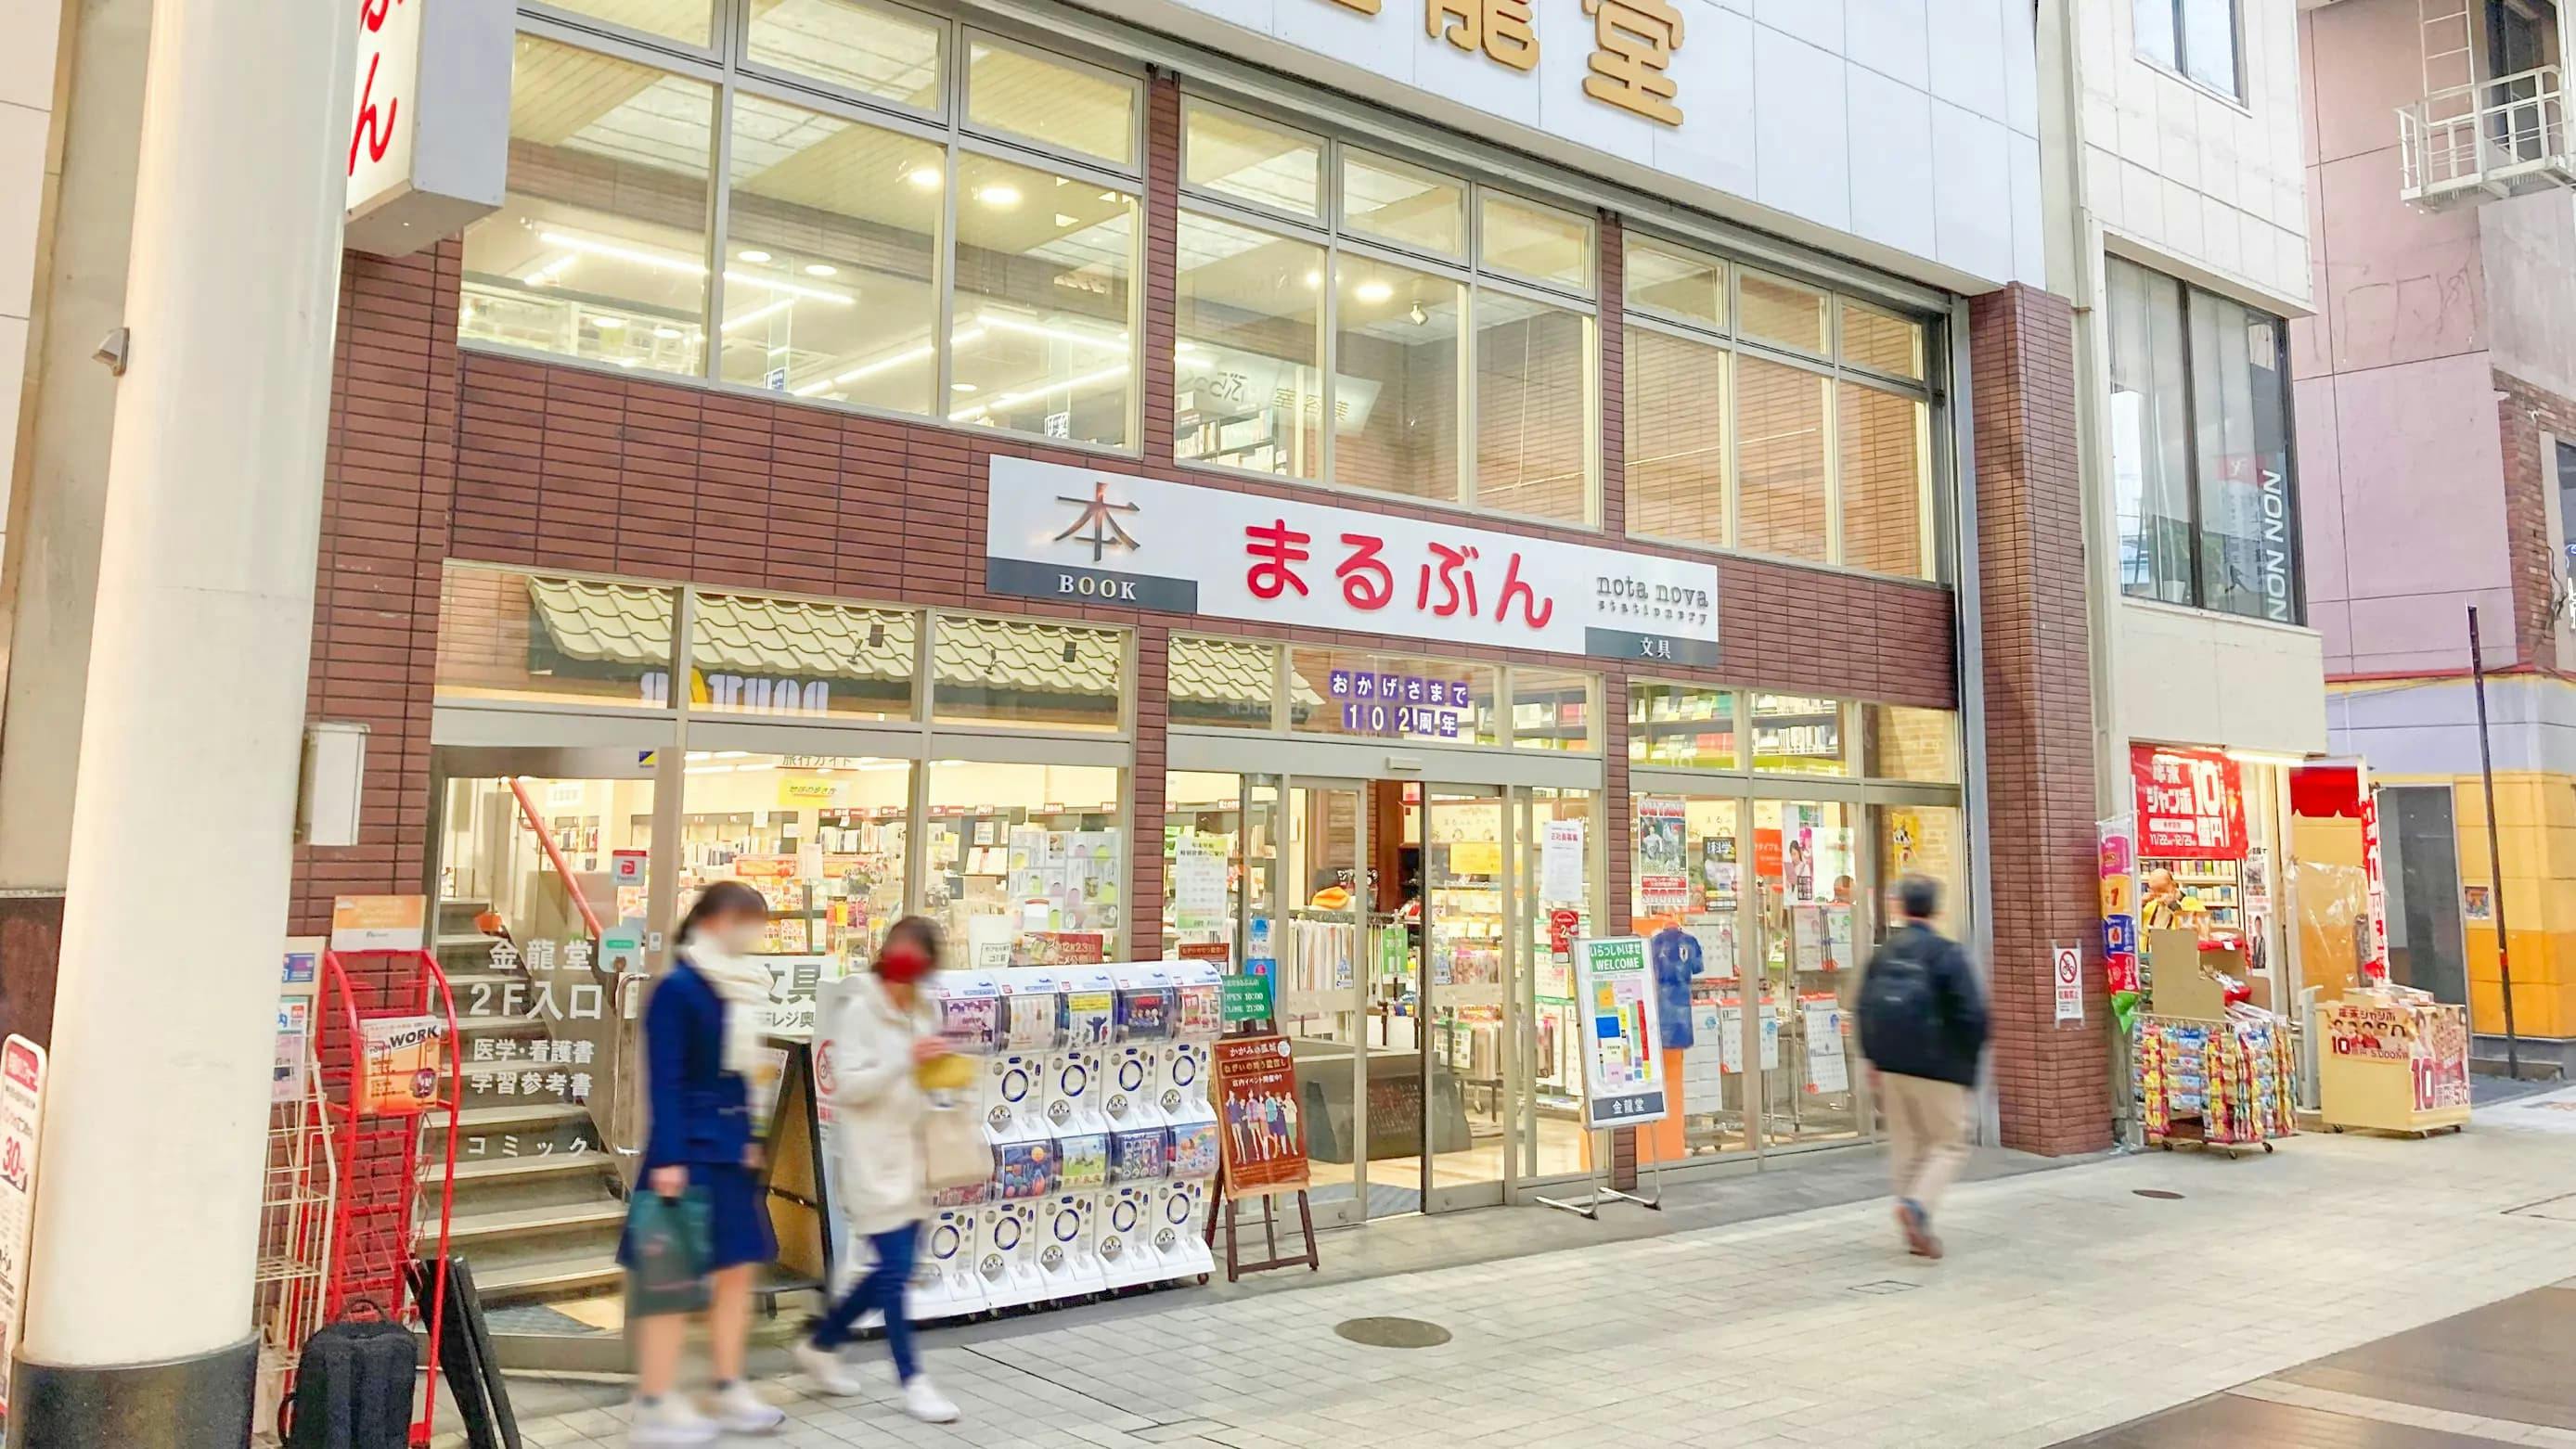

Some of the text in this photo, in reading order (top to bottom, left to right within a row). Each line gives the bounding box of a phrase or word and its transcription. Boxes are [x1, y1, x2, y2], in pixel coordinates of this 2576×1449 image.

[1054, 481, 1140, 561] 本
[1245, 519, 1553, 628] まるぶん
[1058, 574, 1137, 600] BOOK
[1597, 576, 1708, 608] nota nova
[1598, 600, 1708, 627] stationery
[1640, 637, 1671, 660] 文具
[1333, 673, 1467, 705] おかげさまで
[1349, 705, 1456, 735] 102周年
[489, 938, 593, 970] 金龍堂
[1590, 944, 1642, 956] いらっしゃいませ
[1596, 957, 1640, 971] WELCOME
[470, 981, 603, 1020] 2F入口
[390, 1025, 439, 1047] WORK
[473, 1038, 595, 1064] 医学・看護書
[471, 1071, 593, 1097] 学習参考書
[1612, 1097, 1645, 1115] 金龍堂
[468, 1135, 588, 1158] コミック
